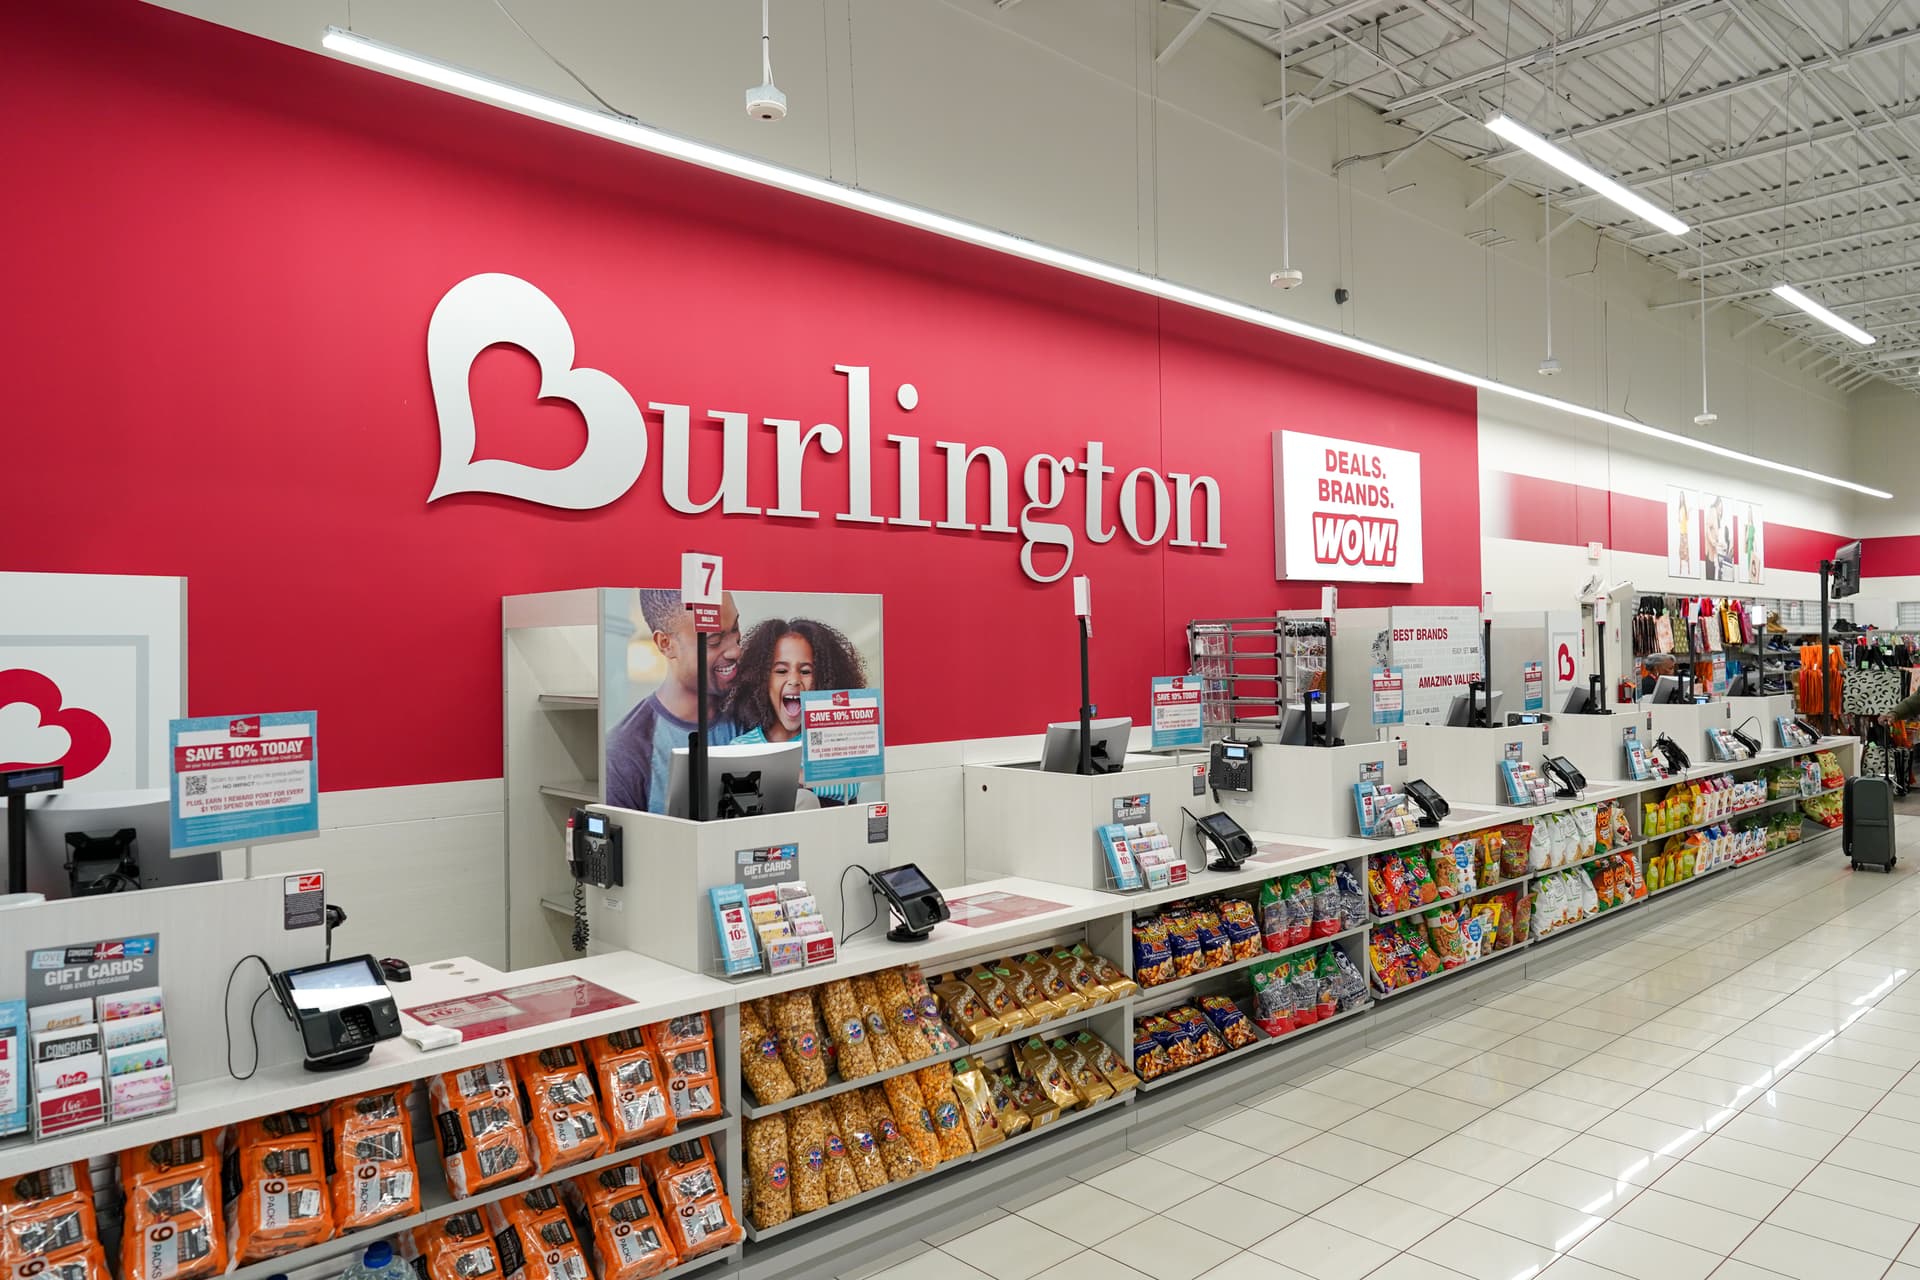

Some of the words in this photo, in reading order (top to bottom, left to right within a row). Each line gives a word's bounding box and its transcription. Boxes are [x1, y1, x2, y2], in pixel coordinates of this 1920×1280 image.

[427, 273, 1227, 583] Burlington
[1325, 448, 1386, 479] DEALS.
[1318, 478, 1394, 509] BRANDS.
[1313, 512, 1398, 567] WOW!
[702, 562, 716, 596] 7
[1393, 629, 1414, 641] BEST
[1416, 628, 1447, 640] BRANDS
[1418, 675, 1452, 688] AMAZING
[1454, 672, 1480, 685] VALUES
[810, 711, 831, 722] SAVE
[832, 710, 849, 720] 10%
[850, 709, 875, 720] TODAY
[185, 747, 224, 762] SAVE
[228, 743, 257, 758] 10%
[260, 740, 304, 756] TODAY
[286, 788, 304, 796] EVERY
[743, 864, 763, 876] GIFT
[764, 860, 792, 873] CARDS
[44, 967, 83, 986] GIFT
[87, 958, 145, 980] CARDS
[74, 980, 96, 989] EVERY
[96, 975, 130, 984] OCCASION
[45, 1039, 92, 1058] CONGRATS
[672, 1080, 686, 1091] 9
[358, 1165, 377, 1180] 9
[264, 1181, 284, 1195] 9
[359, 1181, 368, 1213] PACKS
[266, 1196, 277, 1228] PACKS
[681, 1206, 695, 1218] 9
[150, 1226, 174, 1242] 9
[615, 1225, 631, 1237] 9
[547, 1252, 560, 1265] 9
[620, 1238, 633, 1263] PACKS
[18, 1261, 45, 1278] 9
[151, 1245, 162, 1280] PACKS
